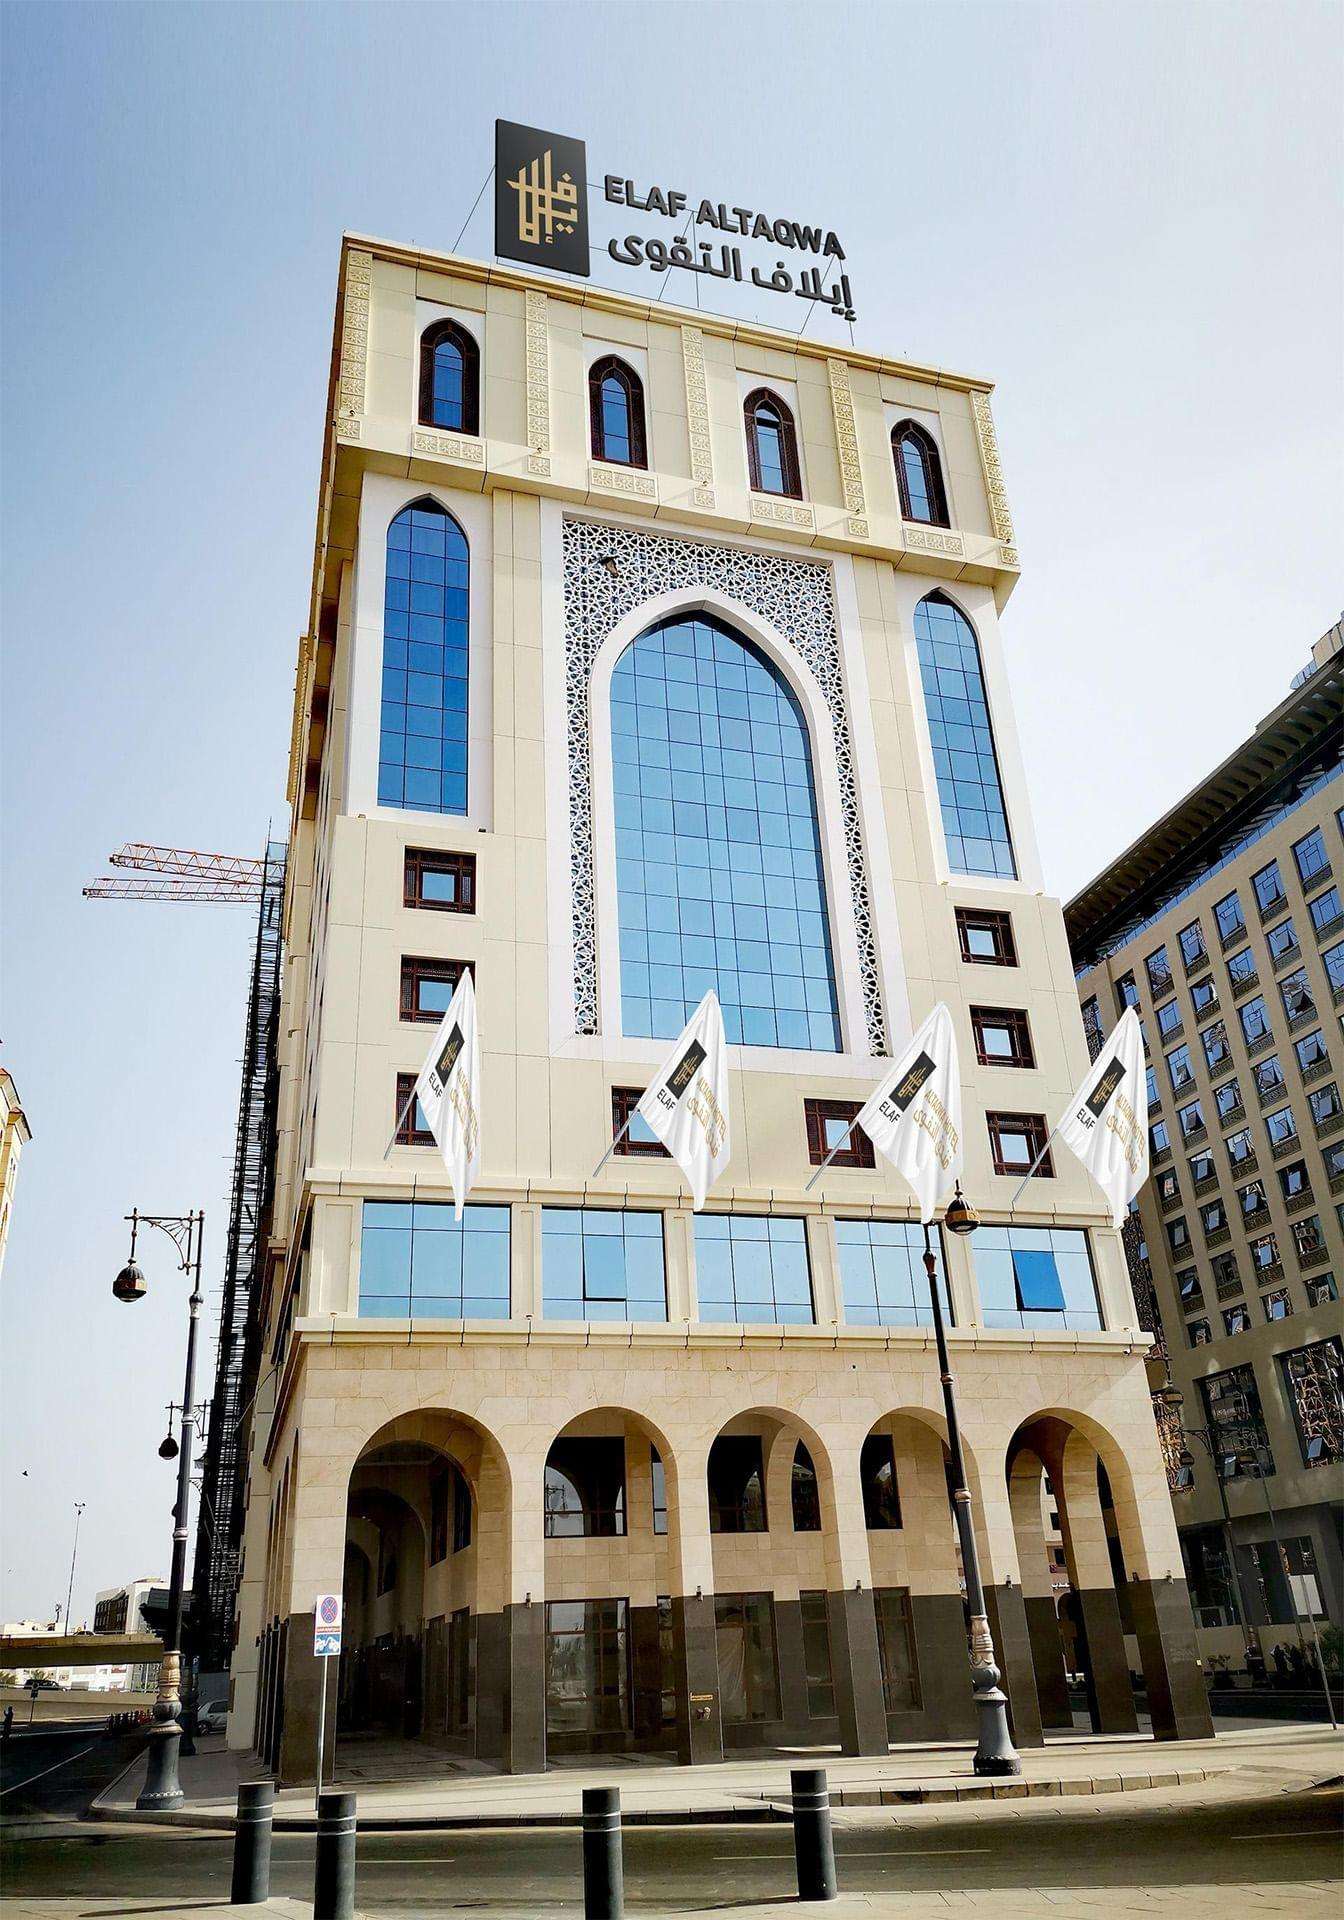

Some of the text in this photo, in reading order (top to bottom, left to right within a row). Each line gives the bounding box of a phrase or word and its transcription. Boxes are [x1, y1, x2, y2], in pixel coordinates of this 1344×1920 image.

[604, 174, 846, 260] ELAF ALTAQWA
[608, 235, 857, 322] إيلاف التقوى
[429, 1072, 443, 1098] ELAF
[657, 1088, 676, 1111] ELAF
[879, 1101, 900, 1123] ELAF
[1077, 1108, 1095, 1130] ELAF
